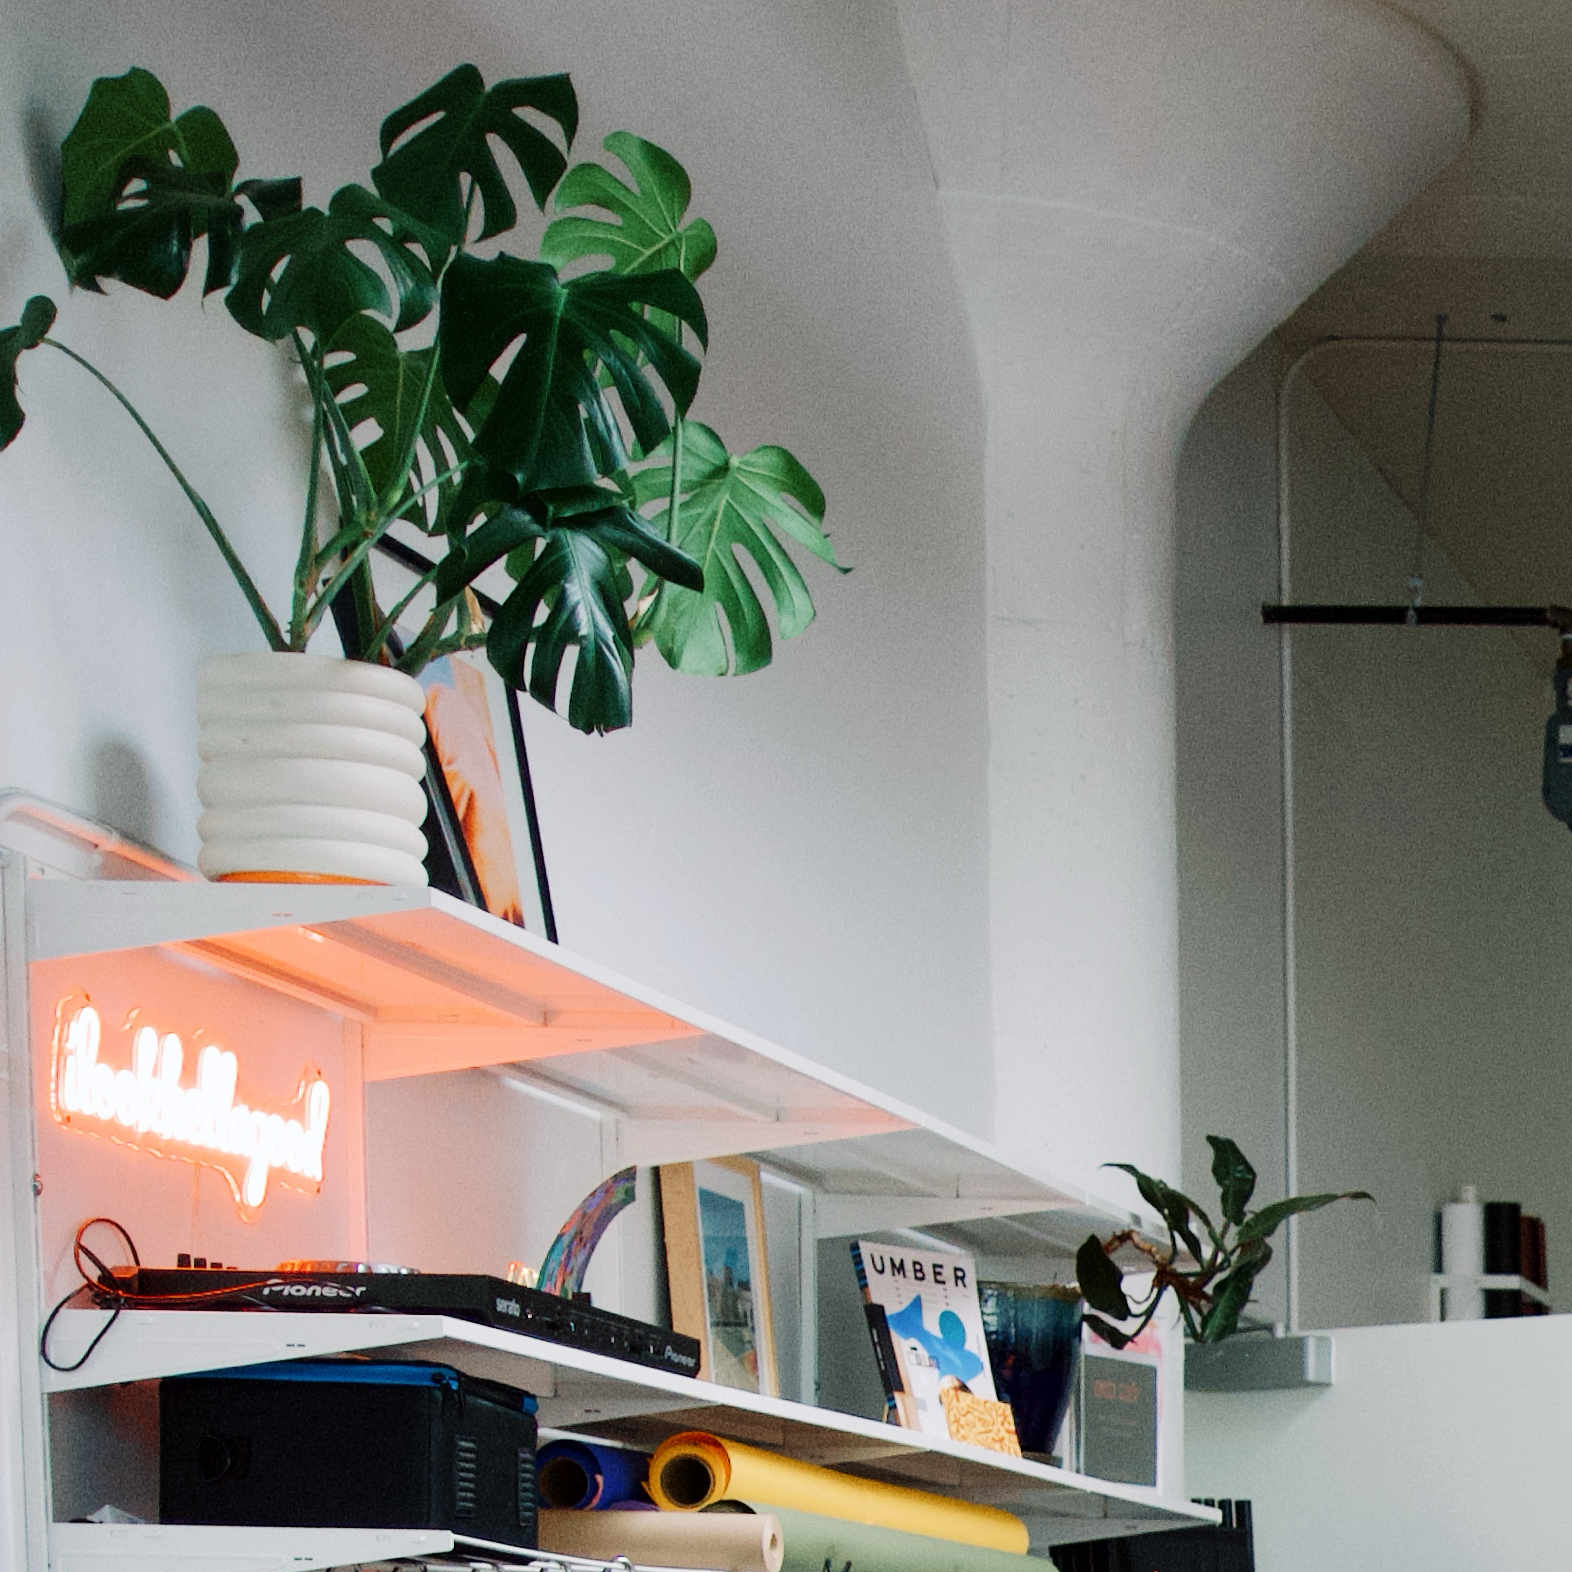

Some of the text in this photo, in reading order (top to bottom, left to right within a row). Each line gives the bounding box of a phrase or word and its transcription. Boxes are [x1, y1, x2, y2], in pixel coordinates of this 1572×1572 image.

[871, 1253, 967, 1289] UMBER
[496, 1298, 520, 1317] serato
[664, 1345, 696, 1367] Pioneer
